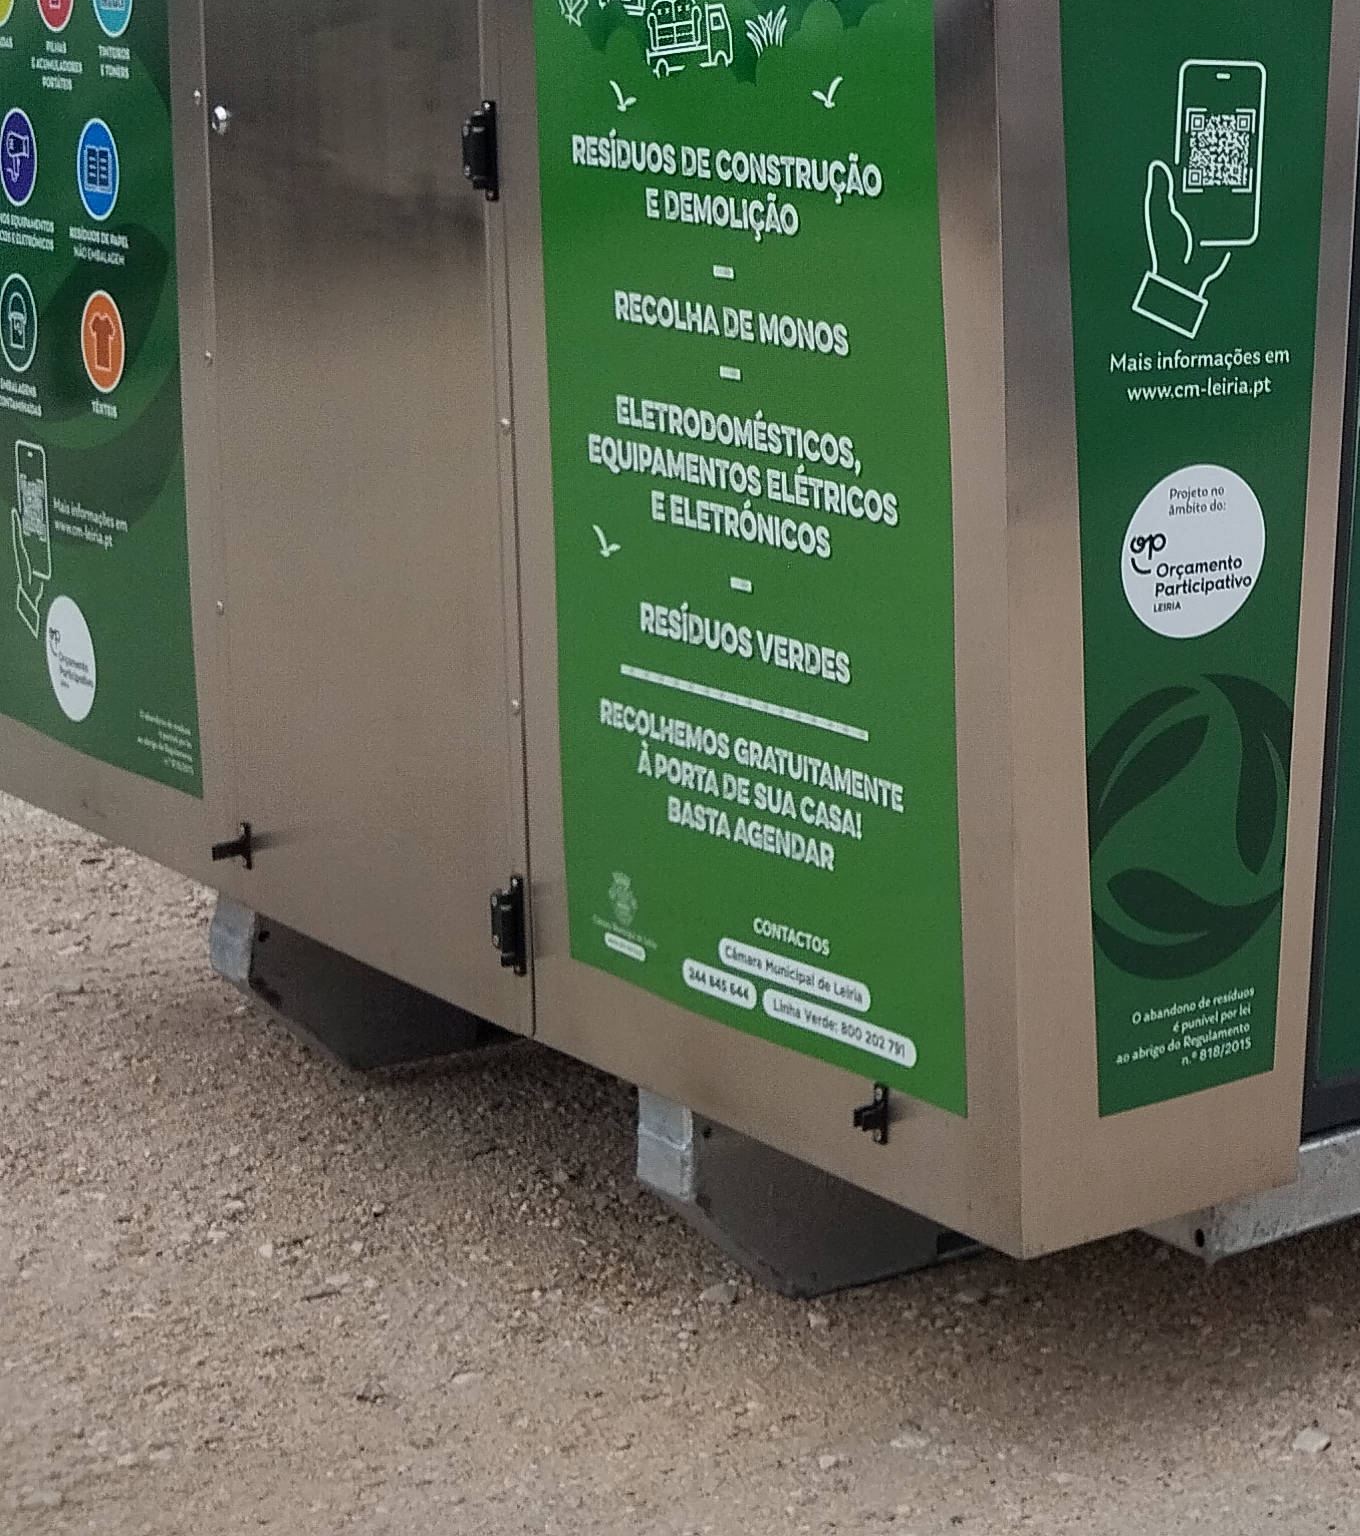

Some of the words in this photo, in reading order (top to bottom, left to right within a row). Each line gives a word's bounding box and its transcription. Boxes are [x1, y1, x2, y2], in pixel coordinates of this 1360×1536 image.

[572, 128, 676, 176] RESÍDUOS
[681, 146, 711, 179] DE
[715, 149, 882, 204] CONSTRUÇÃO
[645, 187, 660, 219] E
[664, 189, 800, 242] DEMOLIÇÃO
[614, 289, 719, 337] RECOLHA
[722, 306, 755, 342] DE
[758, 313, 850, 357] MONOS
[1109, 351, 1153, 373] Mais
[1156, 347, 1261, 372] informações
[1265, 348, 1290, 365] em
[1127, 376, 1272, 402] www.cm-leiria.pt
[615, 393, 862, 477] ELETRODOMÉSTICOS,
[588, 433, 761, 498] EQUIPAMENTOS
[766, 464, 900, 528] ELÉTRICOS
[1169, 486, 1209, 503] Projeto
[1211, 485, 1225, 497] no
[651, 490, 666, 521] E
[670, 498, 831, 559] ELETRÓNICOS
[1168, 500, 1207, 516] âmbito
[1209, 499, 1227, 513] do:
[1154, 574, 1252, 598] Participativo
[1156, 554, 1243, 580] Orçamento
[1153, 601, 1181, 613] LEIRIA
[639, 600, 753, 660] RESÍDUOS
[756, 629, 851, 686] VERDES
[599, 697, 730, 761] RECOLHEMOS
[733, 737, 904, 814] GRATUITAMENTE
[637, 740, 653, 777] À
[655, 757, 719, 799] PORTA
[723, 774, 751, 807] DE
[754, 780, 797, 819] SUA
[800, 797, 863, 840] CASA!
[667, 796, 730, 840] BASTA
[734, 816, 835, 872] AGENDAR
[752, 916, 831, 957] CONTACTOS
[725, 944, 763, 970] Câmara
[766, 958, 815, 989] Municipal
[818, 974, 831, 992] de
[833, 979, 863, 1005] Leiria
[773, 997, 802, 1020] Linha
[804, 1008, 838, 1032] Verde:
[840, 1021, 863, 1042] 800
[865, 1030, 886, 1052] 202
[888, 1038, 906, 1059] 791
[1132, 1011, 1142, 1025] O
[1143, 1002, 1196, 1023] abandono
[1198, 995, 1211, 1009] de
[1213, 986, 1255, 1006] resíduos
[1173, 1021, 1180, 1033] é
[1181, 1013, 1219, 1034] punível
[1220, 1009, 1237, 1024] por
[1239, 1002, 1251, 1017] lei
[1116, 1054, 1131, 1065] ao
[1132, 1043, 1166, 1060] abrigo
[1167, 1038, 1181, 1052] do
[1183, 1022, 1250, 1048] Regulamento
[1199, 1036, 1251, 1062] 818/2015
